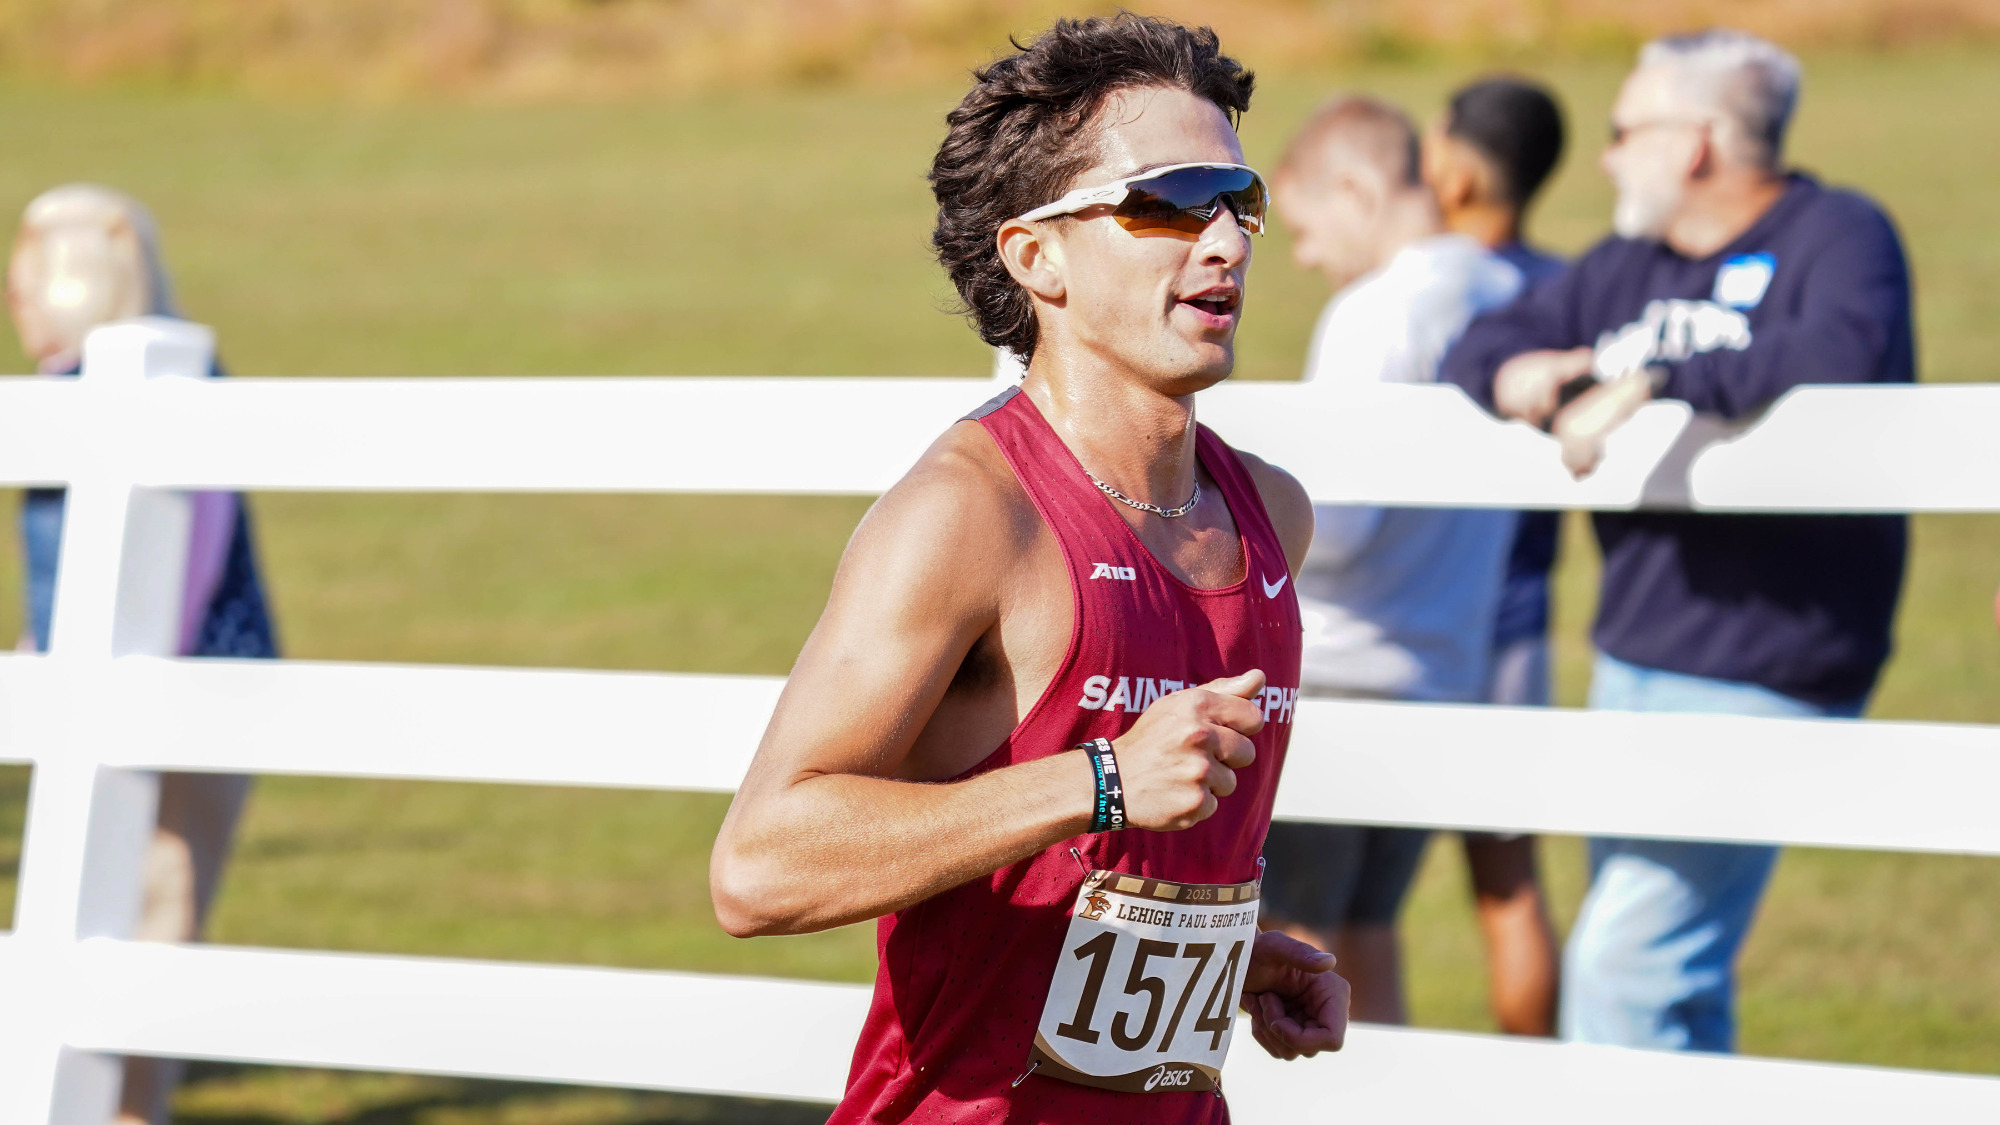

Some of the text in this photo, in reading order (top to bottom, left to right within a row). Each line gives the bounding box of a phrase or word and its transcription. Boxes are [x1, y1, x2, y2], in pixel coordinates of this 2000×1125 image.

[1089, 562, 1136, 581] A10
[1100, 753, 1117, 775] ME
[1185, 888, 1212, 900] 2025
[1116, 903, 1255, 928] LEHIGH PAUL SHORT RUN
[1056, 930, 1246, 1053] 1574
